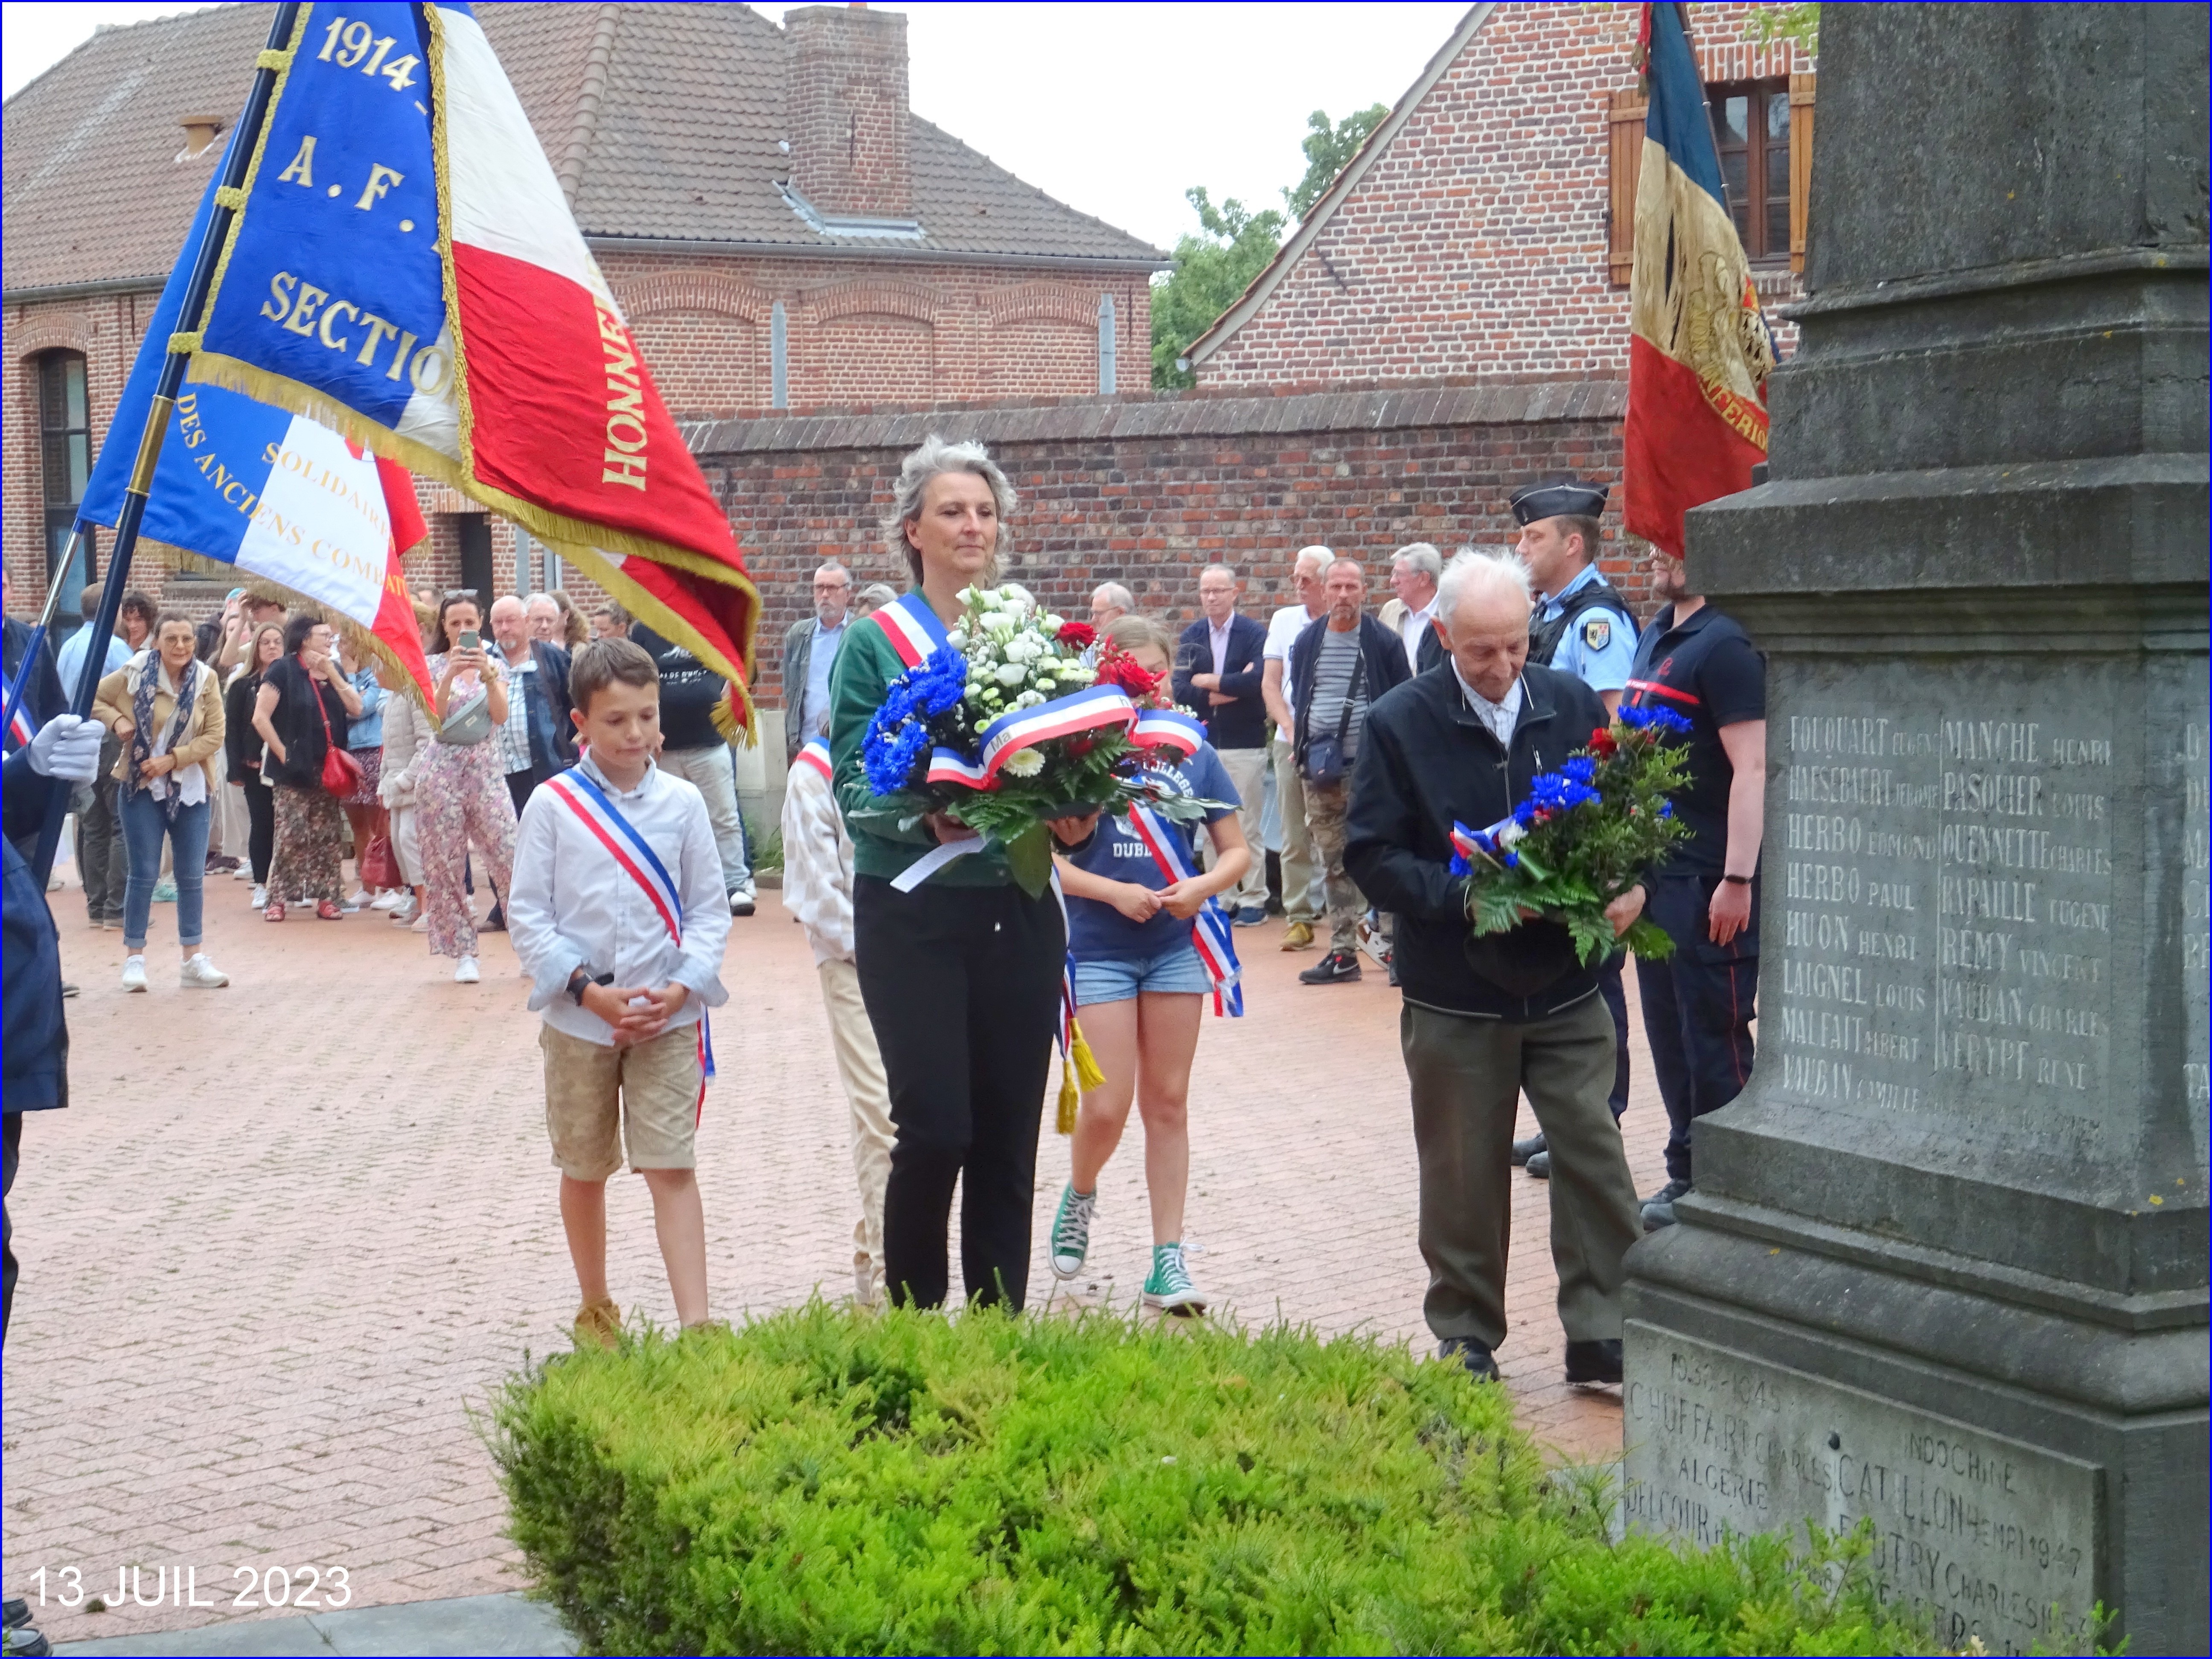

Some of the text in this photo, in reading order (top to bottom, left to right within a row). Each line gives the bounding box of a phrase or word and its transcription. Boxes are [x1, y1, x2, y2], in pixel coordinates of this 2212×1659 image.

[177, 392, 207, 449] DES
[193, 453, 306, 545] ANCIENS
[1944, 720, 2111, 766] MANCHE HENRI
[1788, 813, 1936, 861] HERBO EDMOND
[1943, 824, 2050, 870] QUENNETTE
[1787, 861, 1915, 911] HERBO PAUL
[1786, 909, 1916, 961] HUON HENRI
[1783, 958, 1926, 1012] LAIGNEL LOUIS
[1942, 978, 2023, 1025] VAUBAN
[1781, 1006, 1863, 1054] MALFAIT
[1679, 1455, 1768, 1511] ALGERIE
